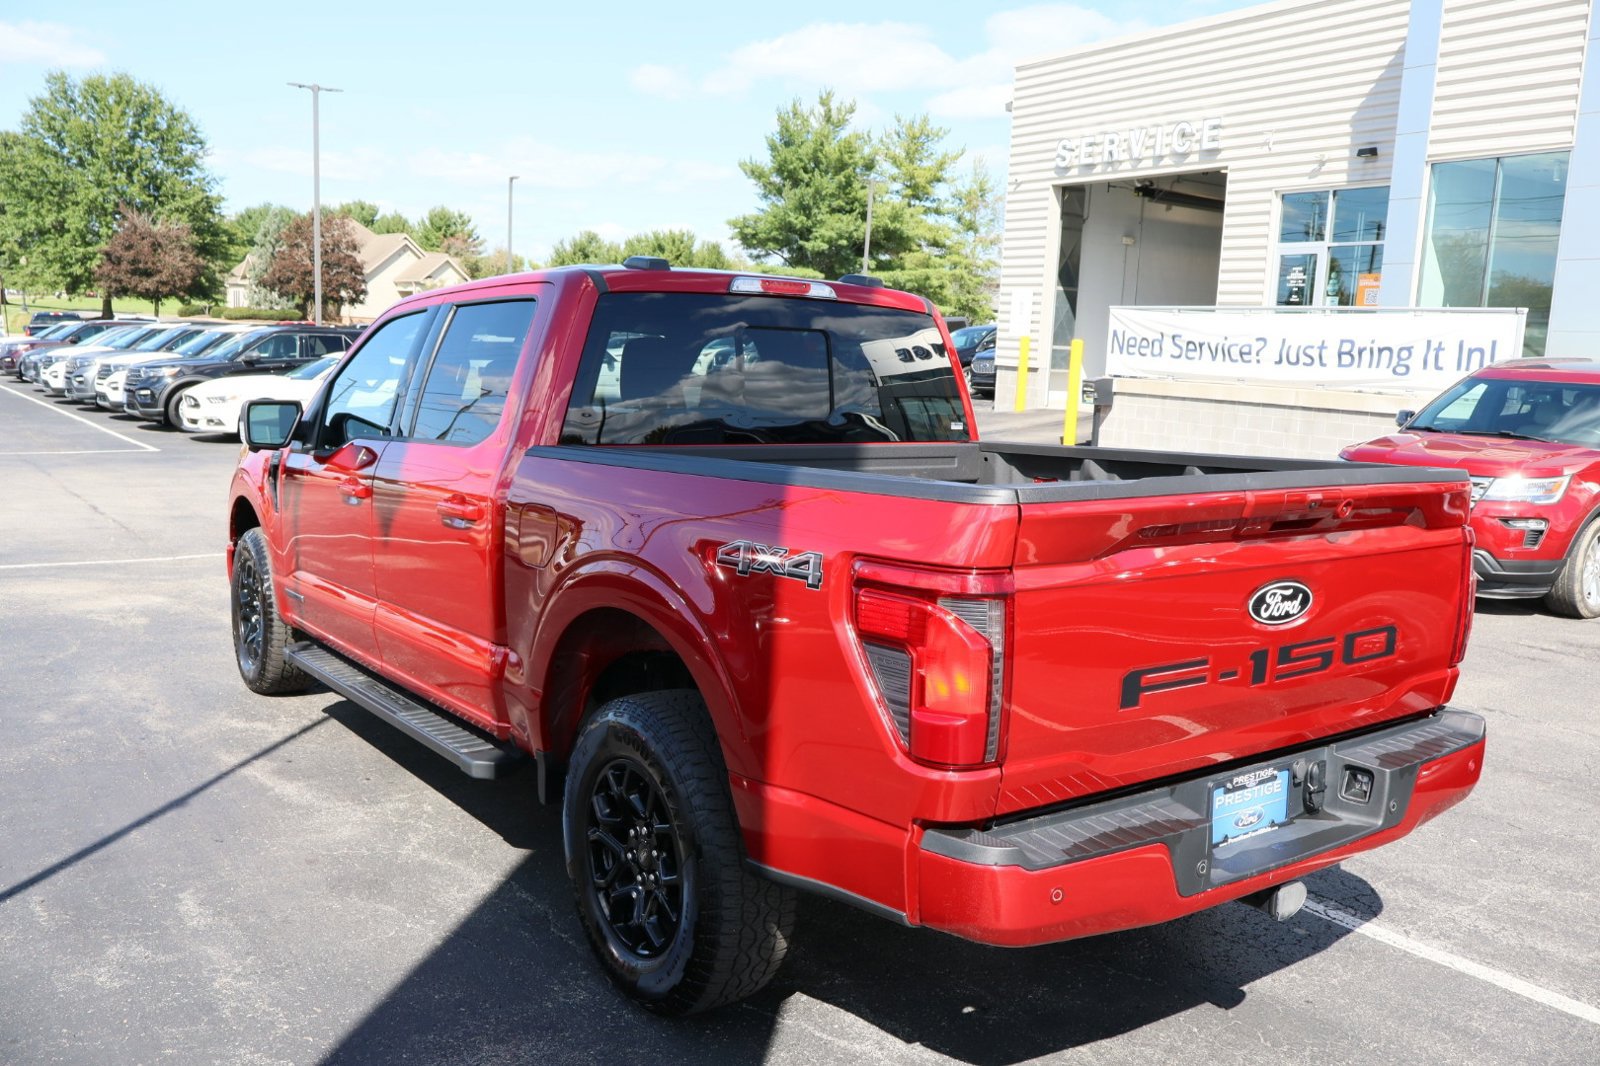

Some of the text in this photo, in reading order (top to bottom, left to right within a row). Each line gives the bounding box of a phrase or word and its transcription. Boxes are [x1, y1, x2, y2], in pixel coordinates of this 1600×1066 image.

[1055, 117, 1222, 168] SERVICE
[1110, 329, 1498, 377] Need Service? Just Bring It In!
[1260, 587, 1302, 618] Ford
[1119, 624, 1398, 711] F-150
[1215, 780, 1282, 809] PRESTIGE
[1233, 768, 1274, 785] PRESTIGE
